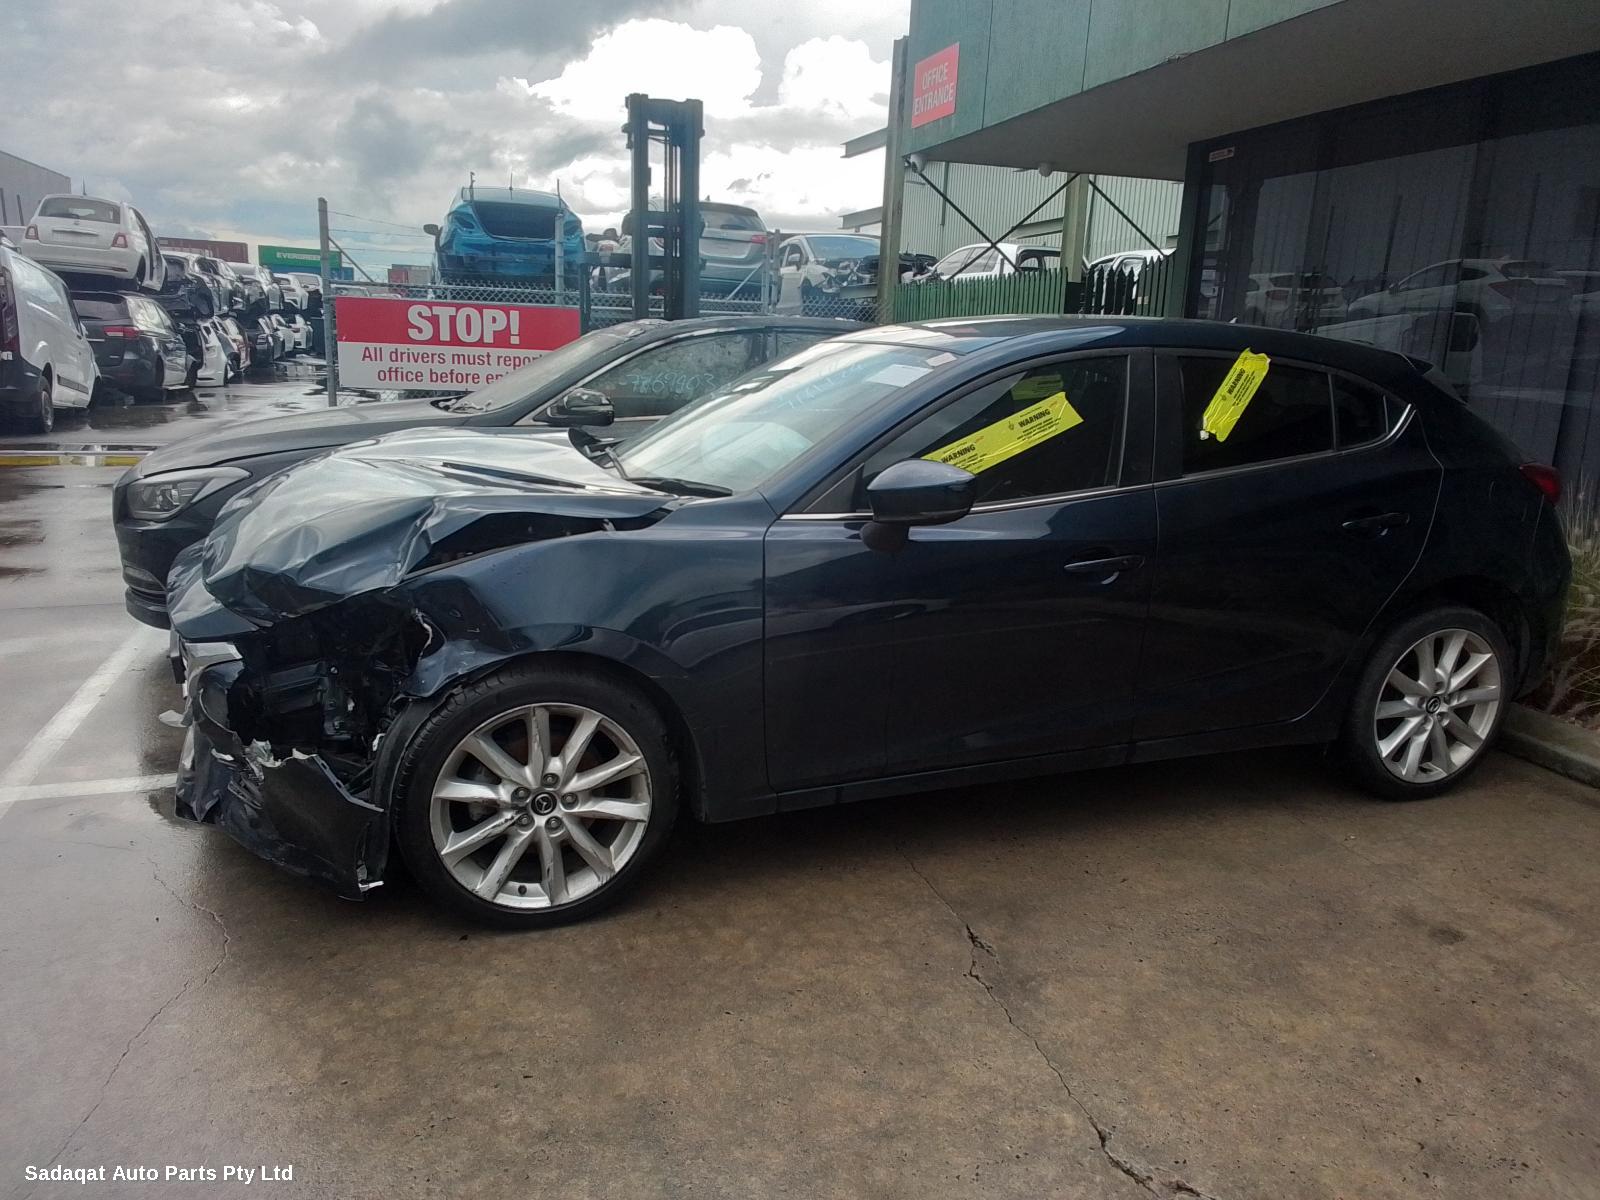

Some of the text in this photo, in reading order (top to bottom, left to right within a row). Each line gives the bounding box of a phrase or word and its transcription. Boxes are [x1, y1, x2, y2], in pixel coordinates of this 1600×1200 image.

[922, 62, 949, 90] OFFICE
[913, 82, 955, 115] ENTRANCE
[407, 304, 521, 345] STOP!
[362, 346, 542, 371] All drivers must repor
[377, 366, 424, 383] office
[429, 368, 479, 385] before
[1226, 367, 1247, 395] WARNING
[1018, 408, 1051, 428] WARNING
[941, 443, 976, 464] WARNING
